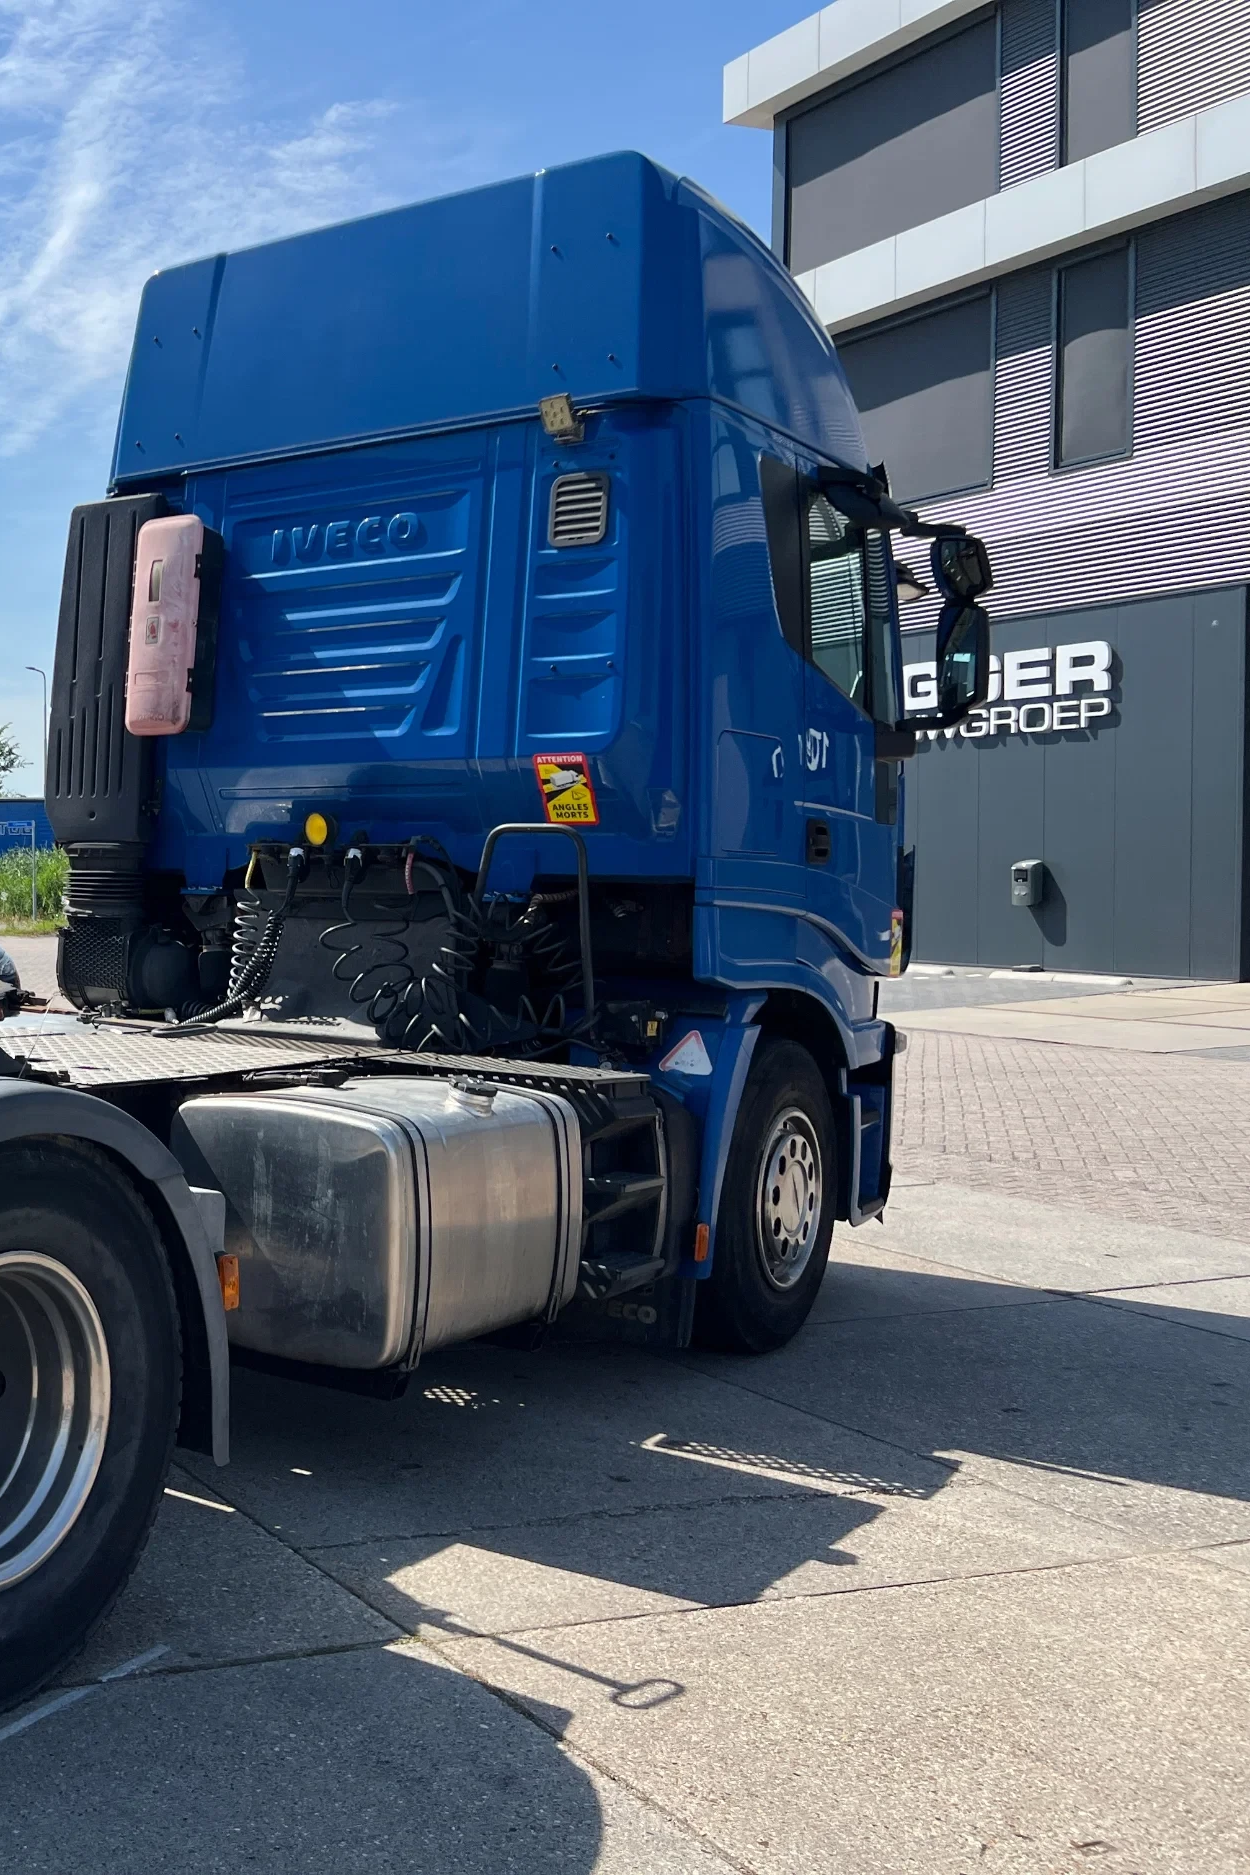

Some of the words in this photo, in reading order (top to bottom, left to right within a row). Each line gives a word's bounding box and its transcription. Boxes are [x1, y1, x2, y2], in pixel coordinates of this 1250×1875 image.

[271, 512, 421, 562] IVECO
[903, 641, 1112, 710] GER
[915, 698, 1112, 741] GROEP
[536, 755, 583, 764] ATTENTION
[552, 803, 589, 811] ANGLES
[555, 811, 589, 819] MORTS
